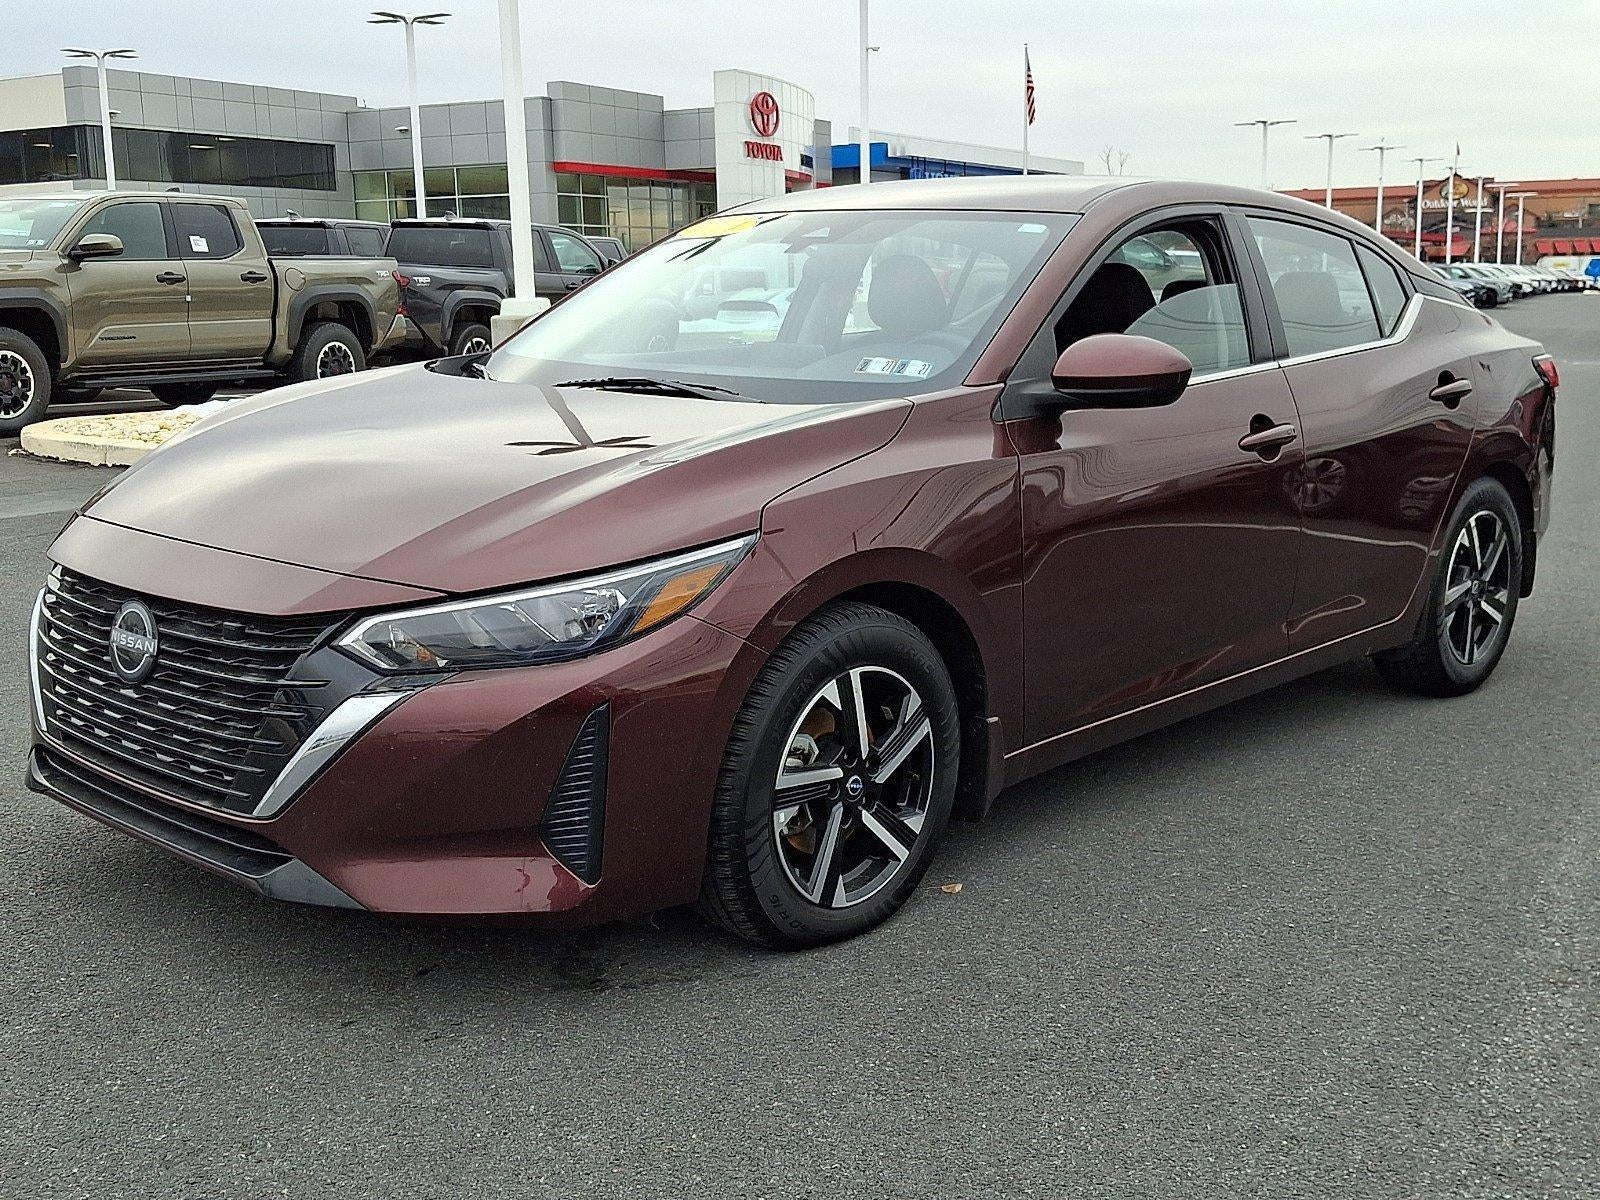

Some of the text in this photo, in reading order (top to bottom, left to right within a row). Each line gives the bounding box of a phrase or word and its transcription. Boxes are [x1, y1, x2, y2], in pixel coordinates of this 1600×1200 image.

[744, 140, 783, 161] TOYOTA
[1422, 197, 1487, 209] Outdor Word
[111, 628, 155, 653] NISSAN
